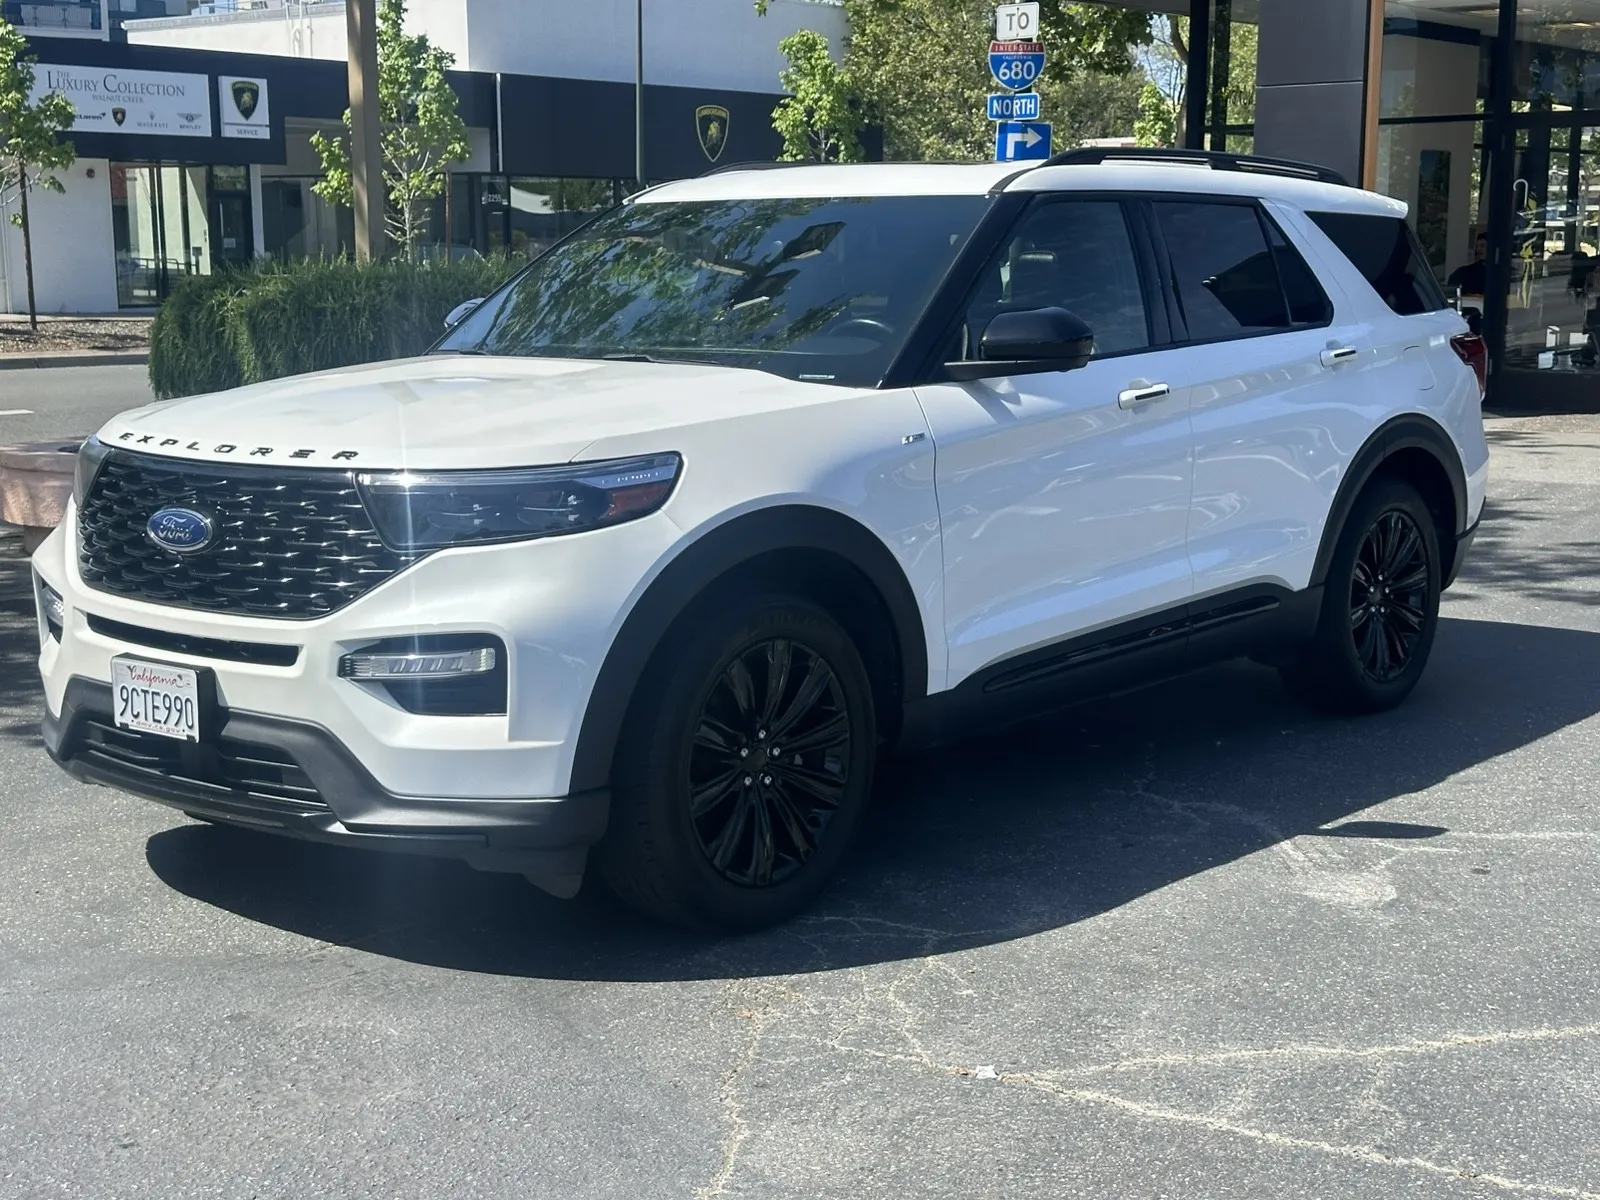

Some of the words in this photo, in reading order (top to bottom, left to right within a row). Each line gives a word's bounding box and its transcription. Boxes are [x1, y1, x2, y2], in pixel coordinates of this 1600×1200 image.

[1005, 12, 1030, 32] TO
[995, 44, 1040, 52] INTERSTATE
[999, 61, 1035, 80] 680
[47, 70, 99, 92] LUXURY
[103, 74, 186, 97] COLLECTION
[92, 94, 121, 102] WALNUT
[122, 96, 144, 104] CREEK
[992, 98, 1035, 116] NORTH
[119, 432, 359, 460] EXPLORER
[158, 515, 196, 541] Ford
[126, 665, 178, 687] California
[119, 685, 195, 730] 9CTE990
[136, 721, 181, 733] dmv.ca.gov
